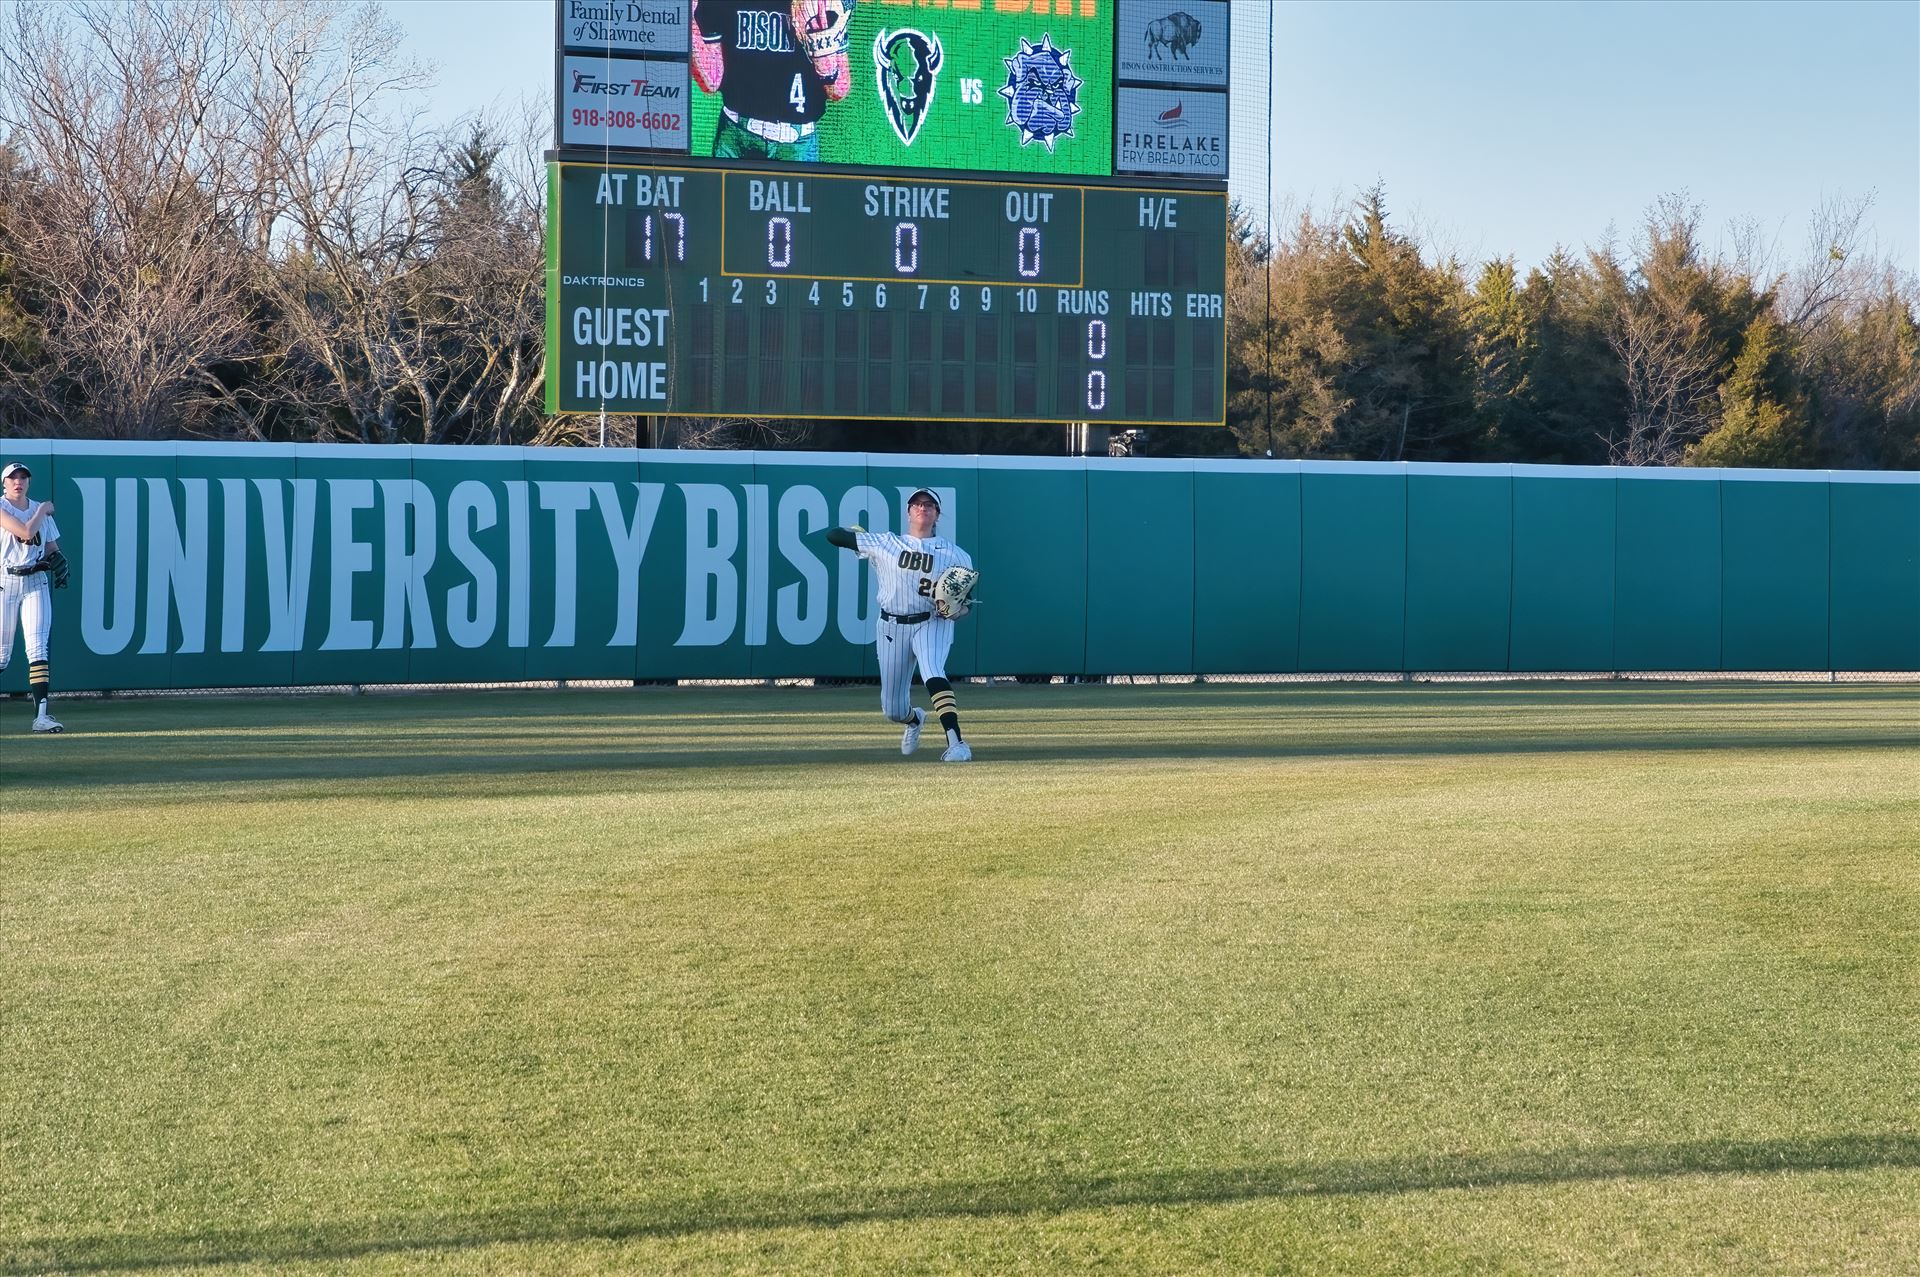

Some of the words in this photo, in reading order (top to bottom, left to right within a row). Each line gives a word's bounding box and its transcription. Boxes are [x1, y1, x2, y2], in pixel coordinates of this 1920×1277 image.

[569, 1, 624, 25] Family
[626, 4, 680, 25] Dental
[573, 21, 589, 41] of
[589, 21, 655, 43] Shawnee
[1142, 63, 1192, 73] CONSTRUCTION
[1193, 65, 1223, 75] SERVICES
[572, 74, 630, 96] FIRST
[631, 79, 680, 99] TEAM
[789, 73, 806, 113] 4
[960, 78, 983, 104] VS
[1122, 150, 1144, 163] FRY
[1147, 151, 1185, 165] BREAD
[1189, 153, 1220, 167] TACO
[1123, 133, 1220, 151] FIRELAKE
[595, 173, 628, 205] AT
[636, 174, 684, 207] BAT
[749, 180, 811, 213] BALL
[864, 185, 949, 218] STRIKE
[1006, 191, 1053, 223] OUT
[1139, 197, 1177, 230] H/E
[644, 212, 685, 261] 17
[768, 217, 791, 268] 0
[895, 222, 917, 272] 0
[1018, 227, 1040, 276] 0
[563, 275, 645, 287] DAKTRONICS
[699, 277, 708, 302] 1
[731, 279, 743, 304] 2
[766, 280, 777, 305] 3
[808, 281, 820, 306] 4
[842, 282, 853, 307] 5
[875, 283, 886, 308] 6
[917, 285, 928, 309] 7
[950, 286, 960, 311] 8
[981, 287, 991, 311] 9
[1016, 288, 1037, 313] 10
[1057, 289, 1109, 315] RUNS
[1130, 292, 1172, 317] HITS
[1186, 293, 1222, 318] ERR
[573, 306, 670, 347] GUEST
[1088, 320, 1106, 359] 0
[576, 361, 666, 400] HOME
[1087, 370, 1105, 409] 0
[72, 477, 665, 655] UNIVERSITY
[898, 550, 933, 573] OBU
